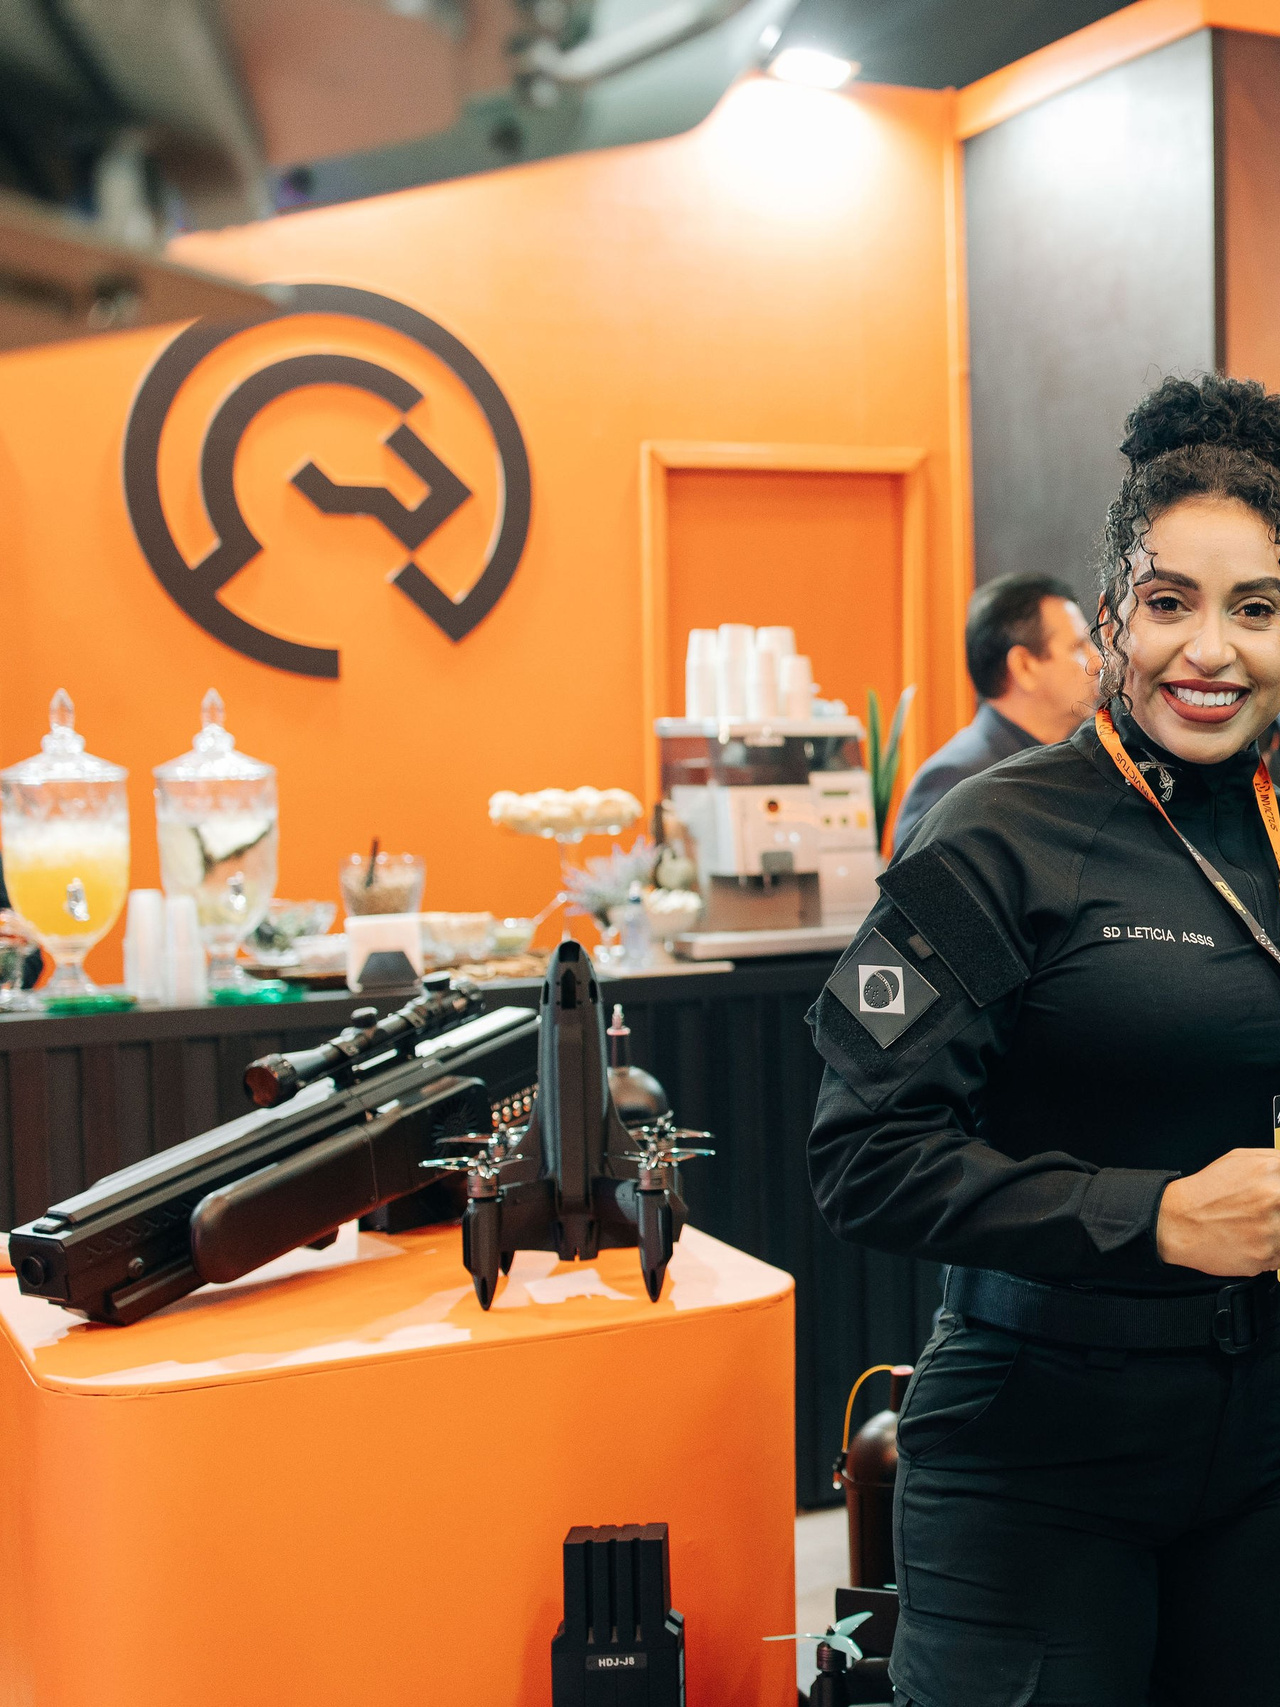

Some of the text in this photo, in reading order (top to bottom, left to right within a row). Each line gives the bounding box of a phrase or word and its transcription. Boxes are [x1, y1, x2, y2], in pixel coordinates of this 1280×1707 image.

[1114, 752, 1151, 800] INVICTUS
[1261, 789, 1279, 832] INVICTUS
[1102, 926, 1215, 948] SD LETICIA ASSIS
[597, 1656, 636, 1669] HDJ-J8
